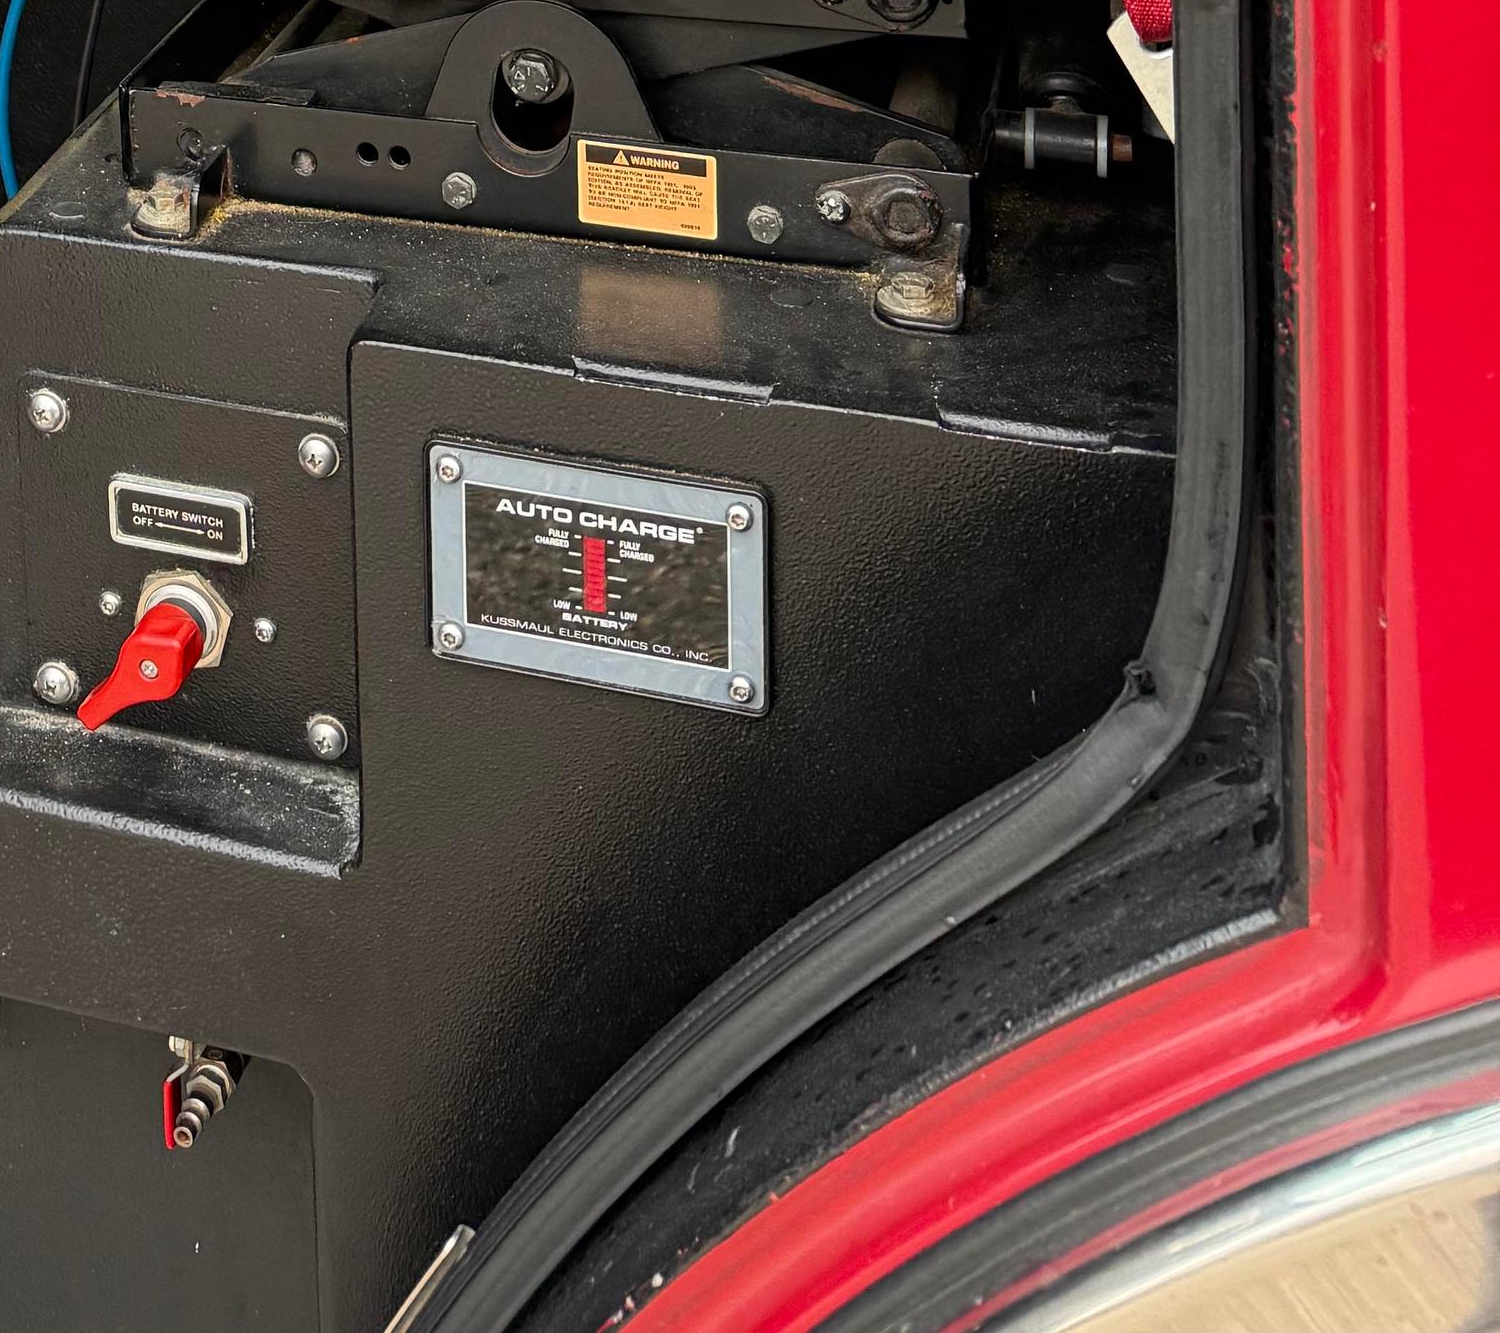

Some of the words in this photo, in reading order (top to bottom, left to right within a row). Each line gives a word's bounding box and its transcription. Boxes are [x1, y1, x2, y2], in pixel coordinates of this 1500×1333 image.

[630, 155, 680, 170] WARNING
[588, 172, 633, 181] REQUIREMENTS
[615, 169, 642, 177] POSITION
[603, 185, 631, 193] BRACKET
[664, 187, 692, 195] REMOVAL
[131, 502, 179, 520] BATTERY
[181, 511, 223, 528] SWITCH
[496, 498, 573, 524] AUTO
[579, 513, 695, 545] CHARGE
[132, 515, 154, 527] OFF
[207, 529, 223, 541] ON
[548, 528, 569, 539] FULLY
[535, 535, 570, 548] CHARGED
[619, 540, 641, 551] FULLY
[619, 549, 654, 563] CHARGED
[553, 599, 571, 610] LOW
[620, 610, 638, 622] LOW
[562, 613, 628, 632] BATTERY
[480, 614, 554, 635] KUSSMAUL
[558, 627, 648, 652] ELECTRONICS
[685, 650, 714, 664] INC.
